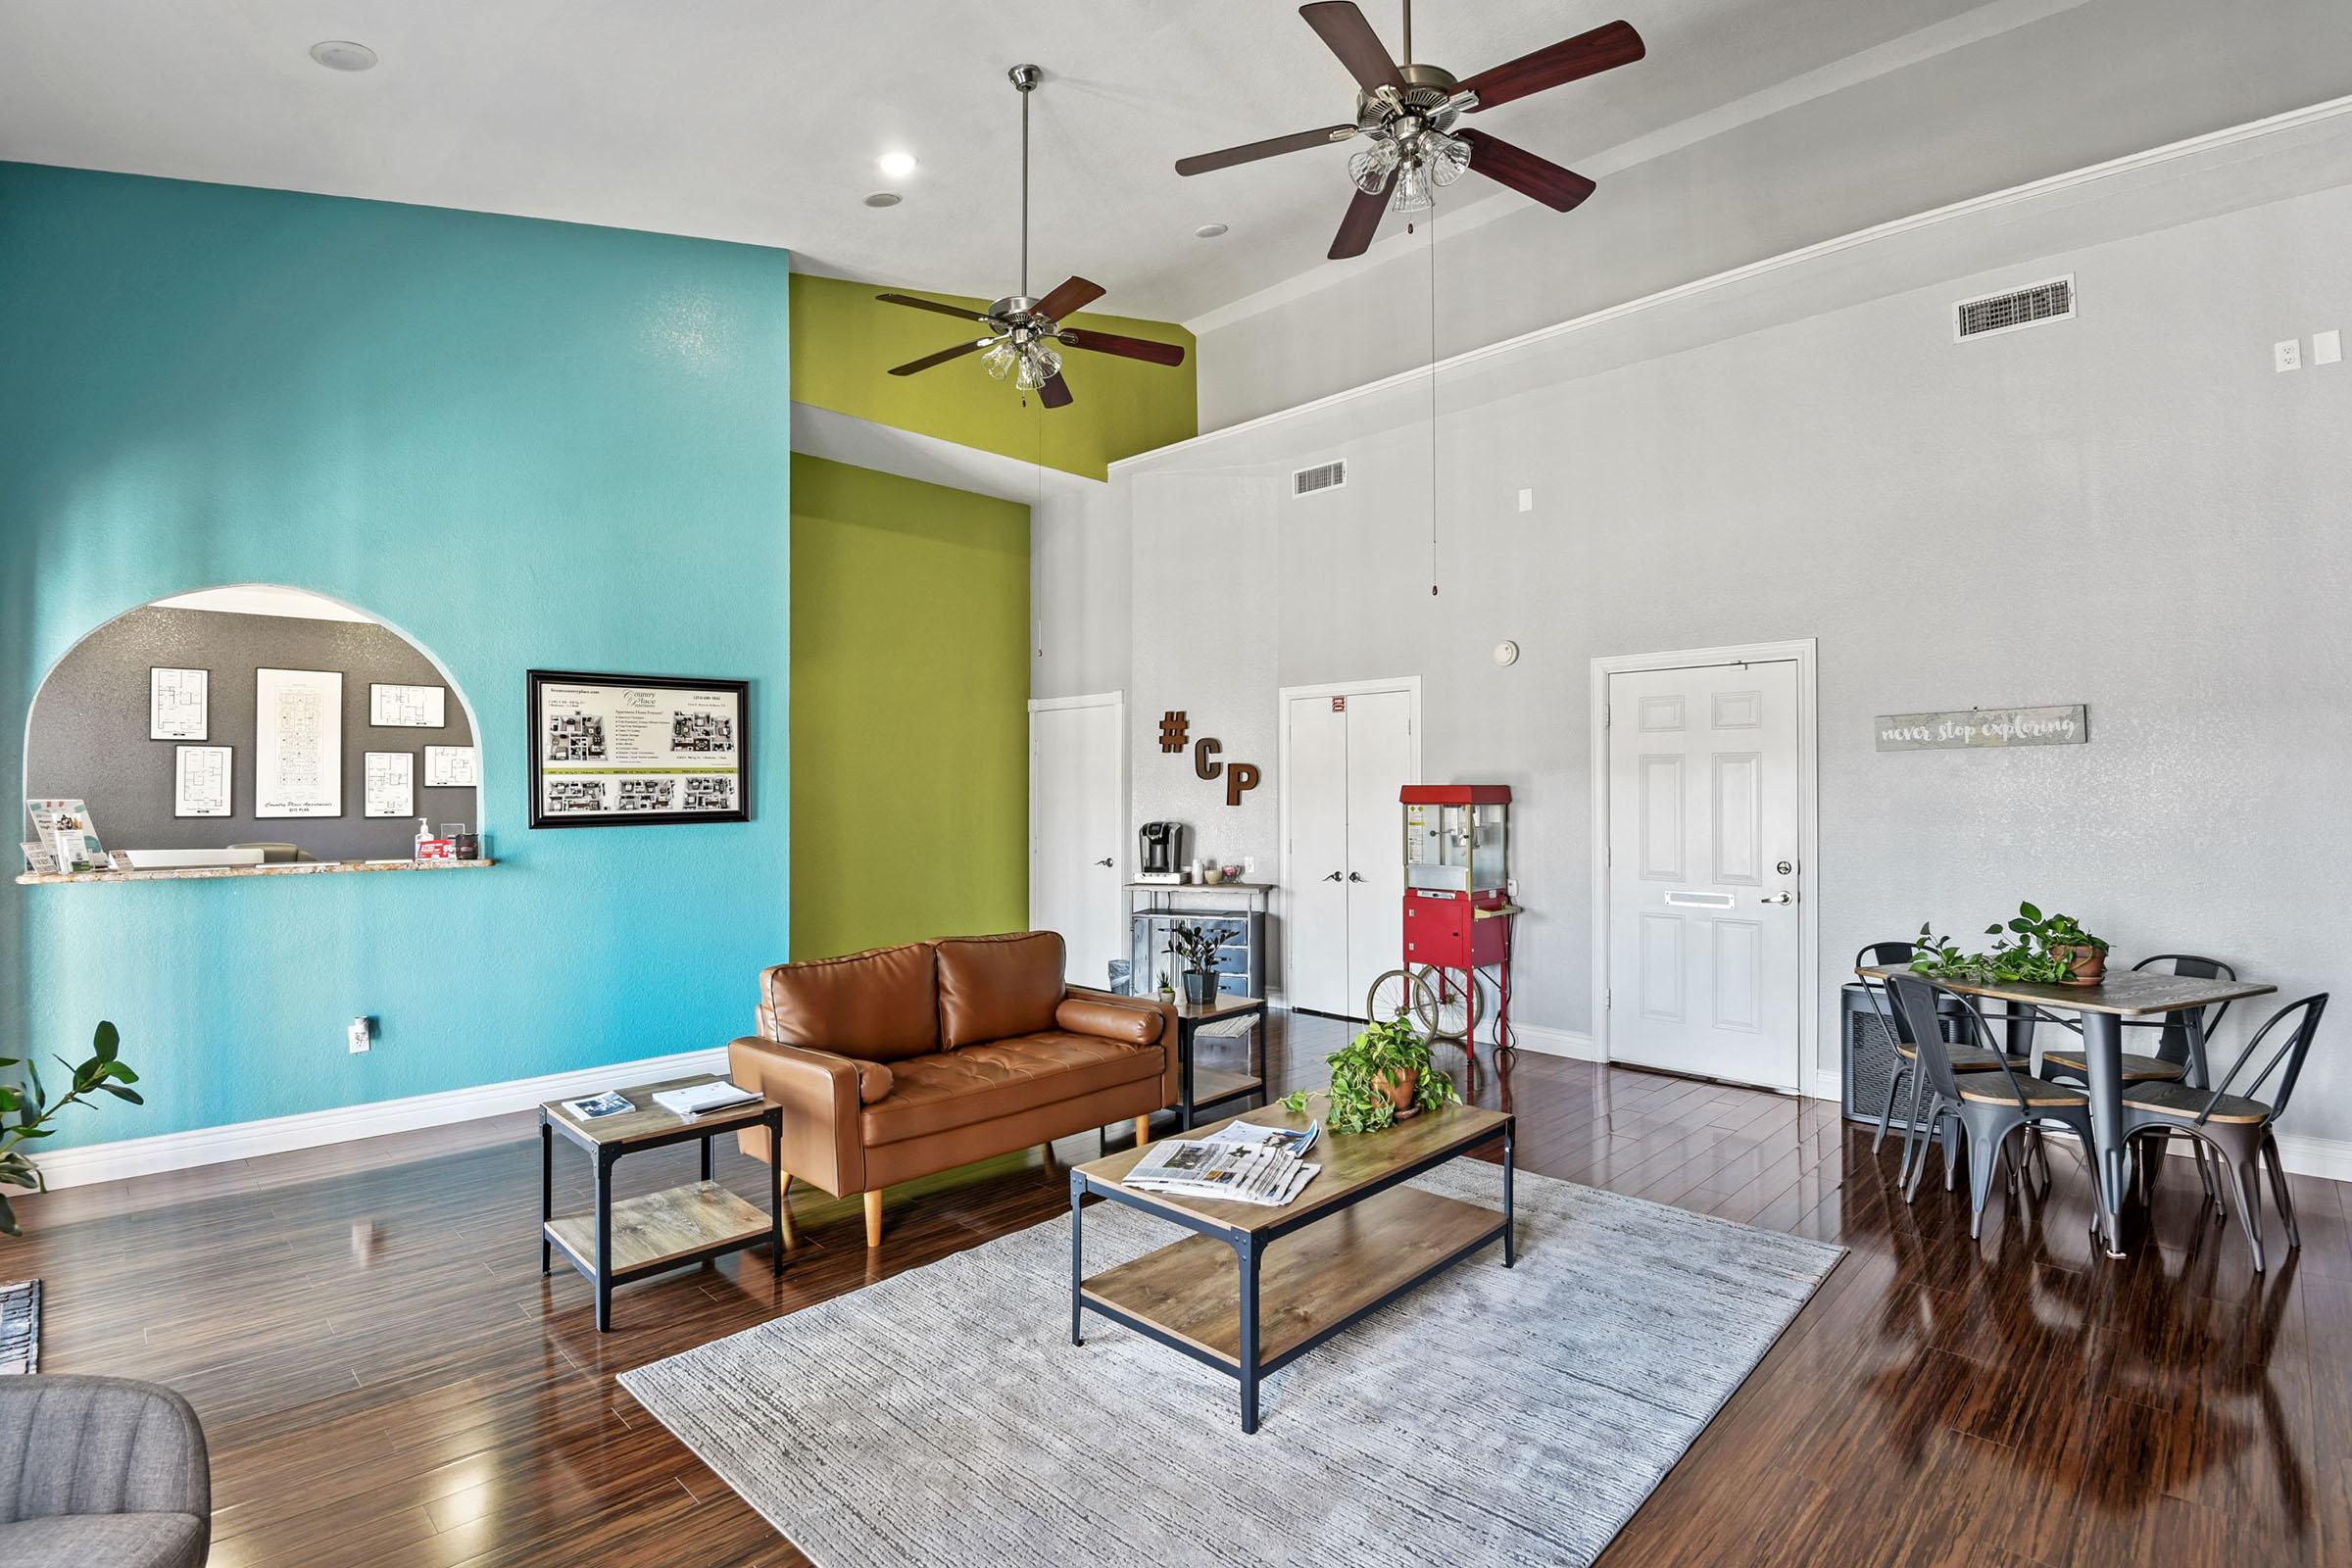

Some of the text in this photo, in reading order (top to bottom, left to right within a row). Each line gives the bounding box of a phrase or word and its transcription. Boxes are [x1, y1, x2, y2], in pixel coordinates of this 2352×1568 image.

[1882, 715, 2078, 745] never stop exploring
